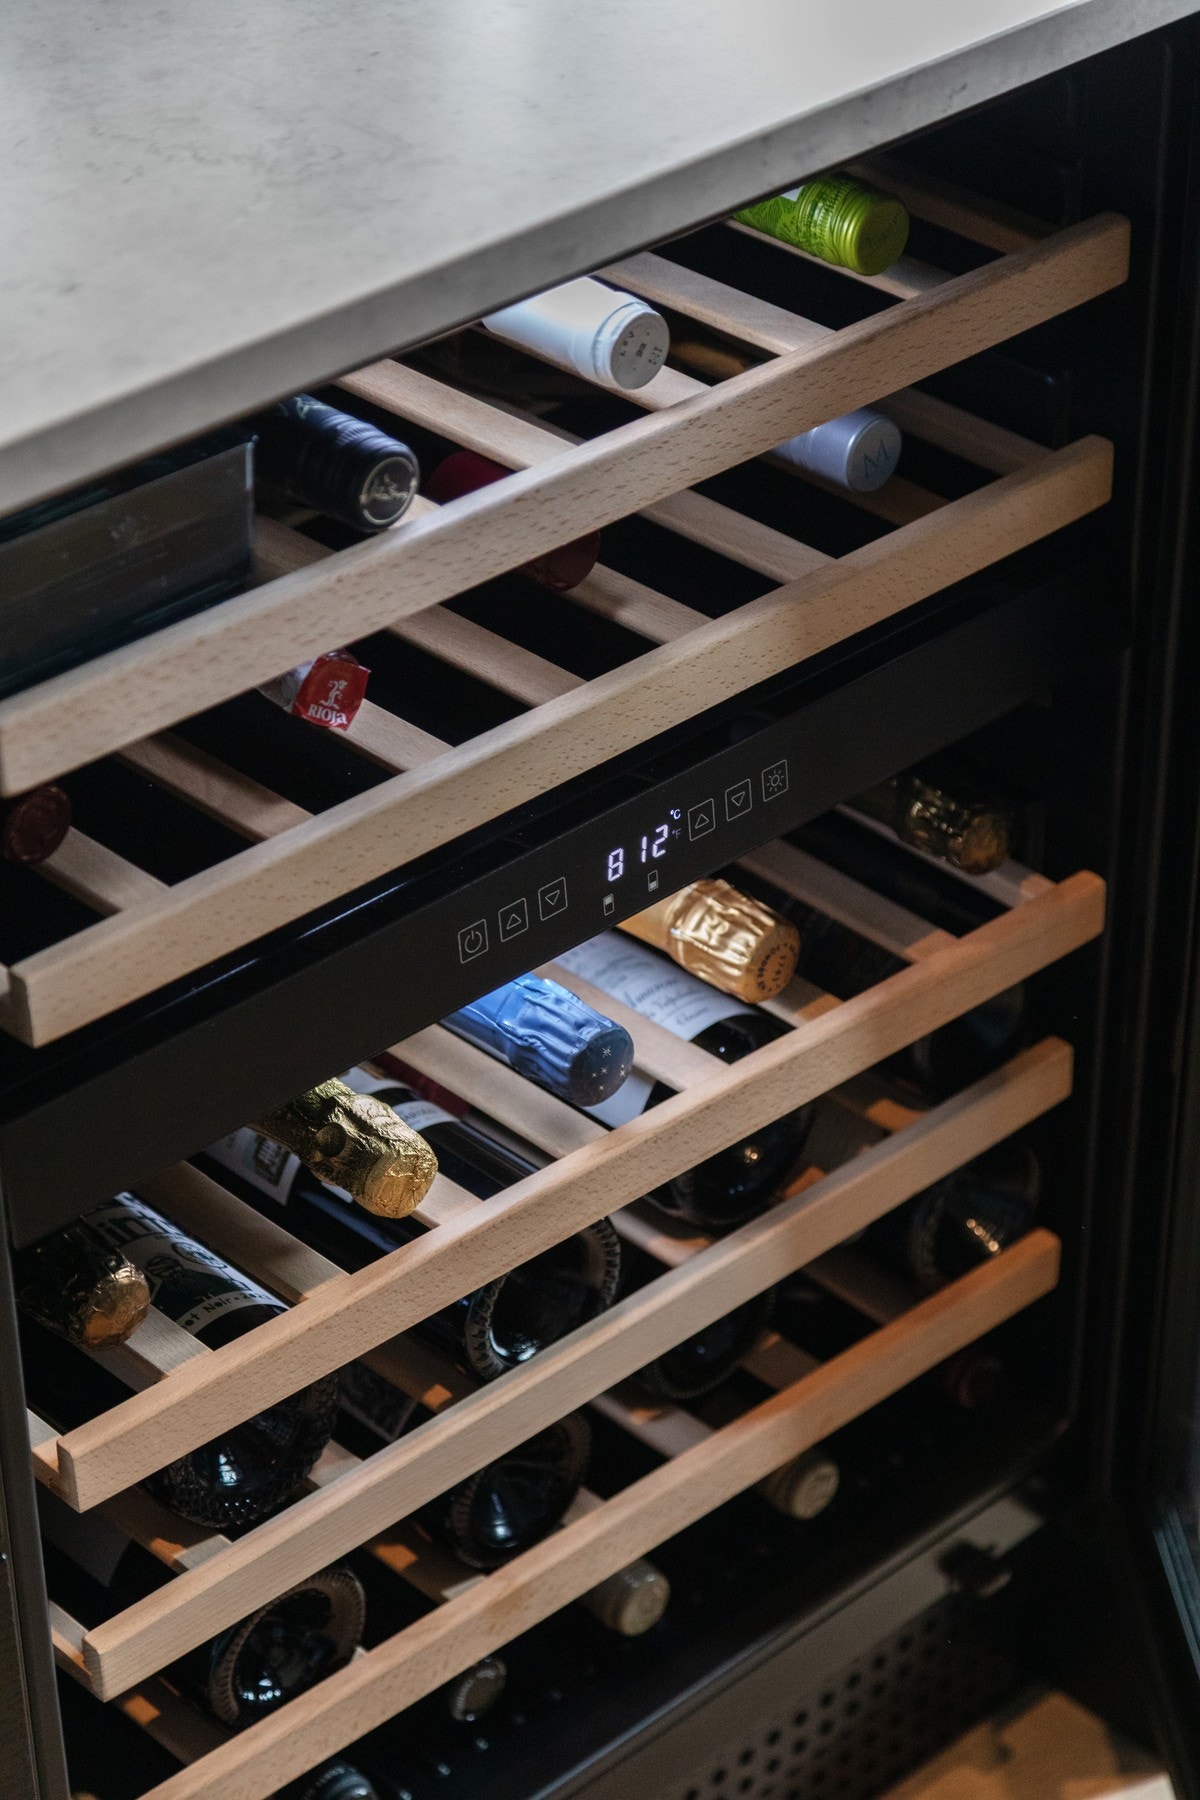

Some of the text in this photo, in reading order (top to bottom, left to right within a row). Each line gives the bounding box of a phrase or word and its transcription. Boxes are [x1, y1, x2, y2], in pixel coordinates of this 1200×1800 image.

[607, 824, 669, 882] 8 12
[203, 1298, 232, 1313] Noir
